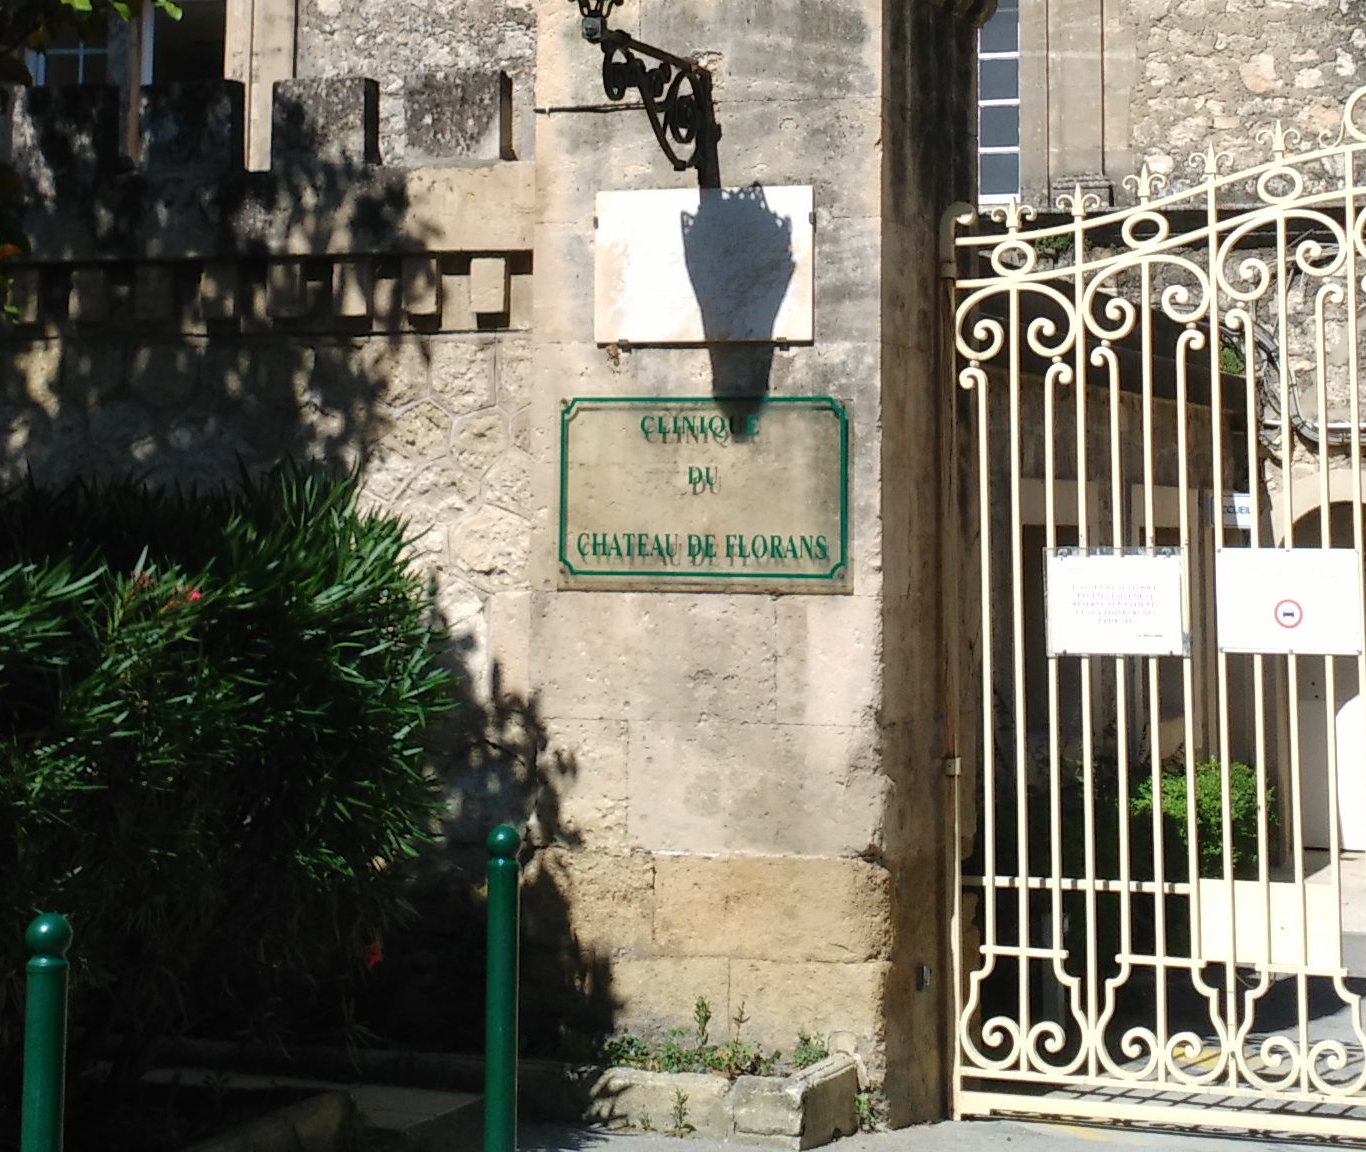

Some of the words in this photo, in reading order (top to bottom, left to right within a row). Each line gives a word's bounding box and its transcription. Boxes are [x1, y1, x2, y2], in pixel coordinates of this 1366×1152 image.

[640, 415, 760, 437] CLINIQUE
[688, 466, 718, 486] DU
[577, 532, 679, 559] CHATEAU
[687, 534, 717, 558] DE
[725, 534, 828, 560] FLORANS
